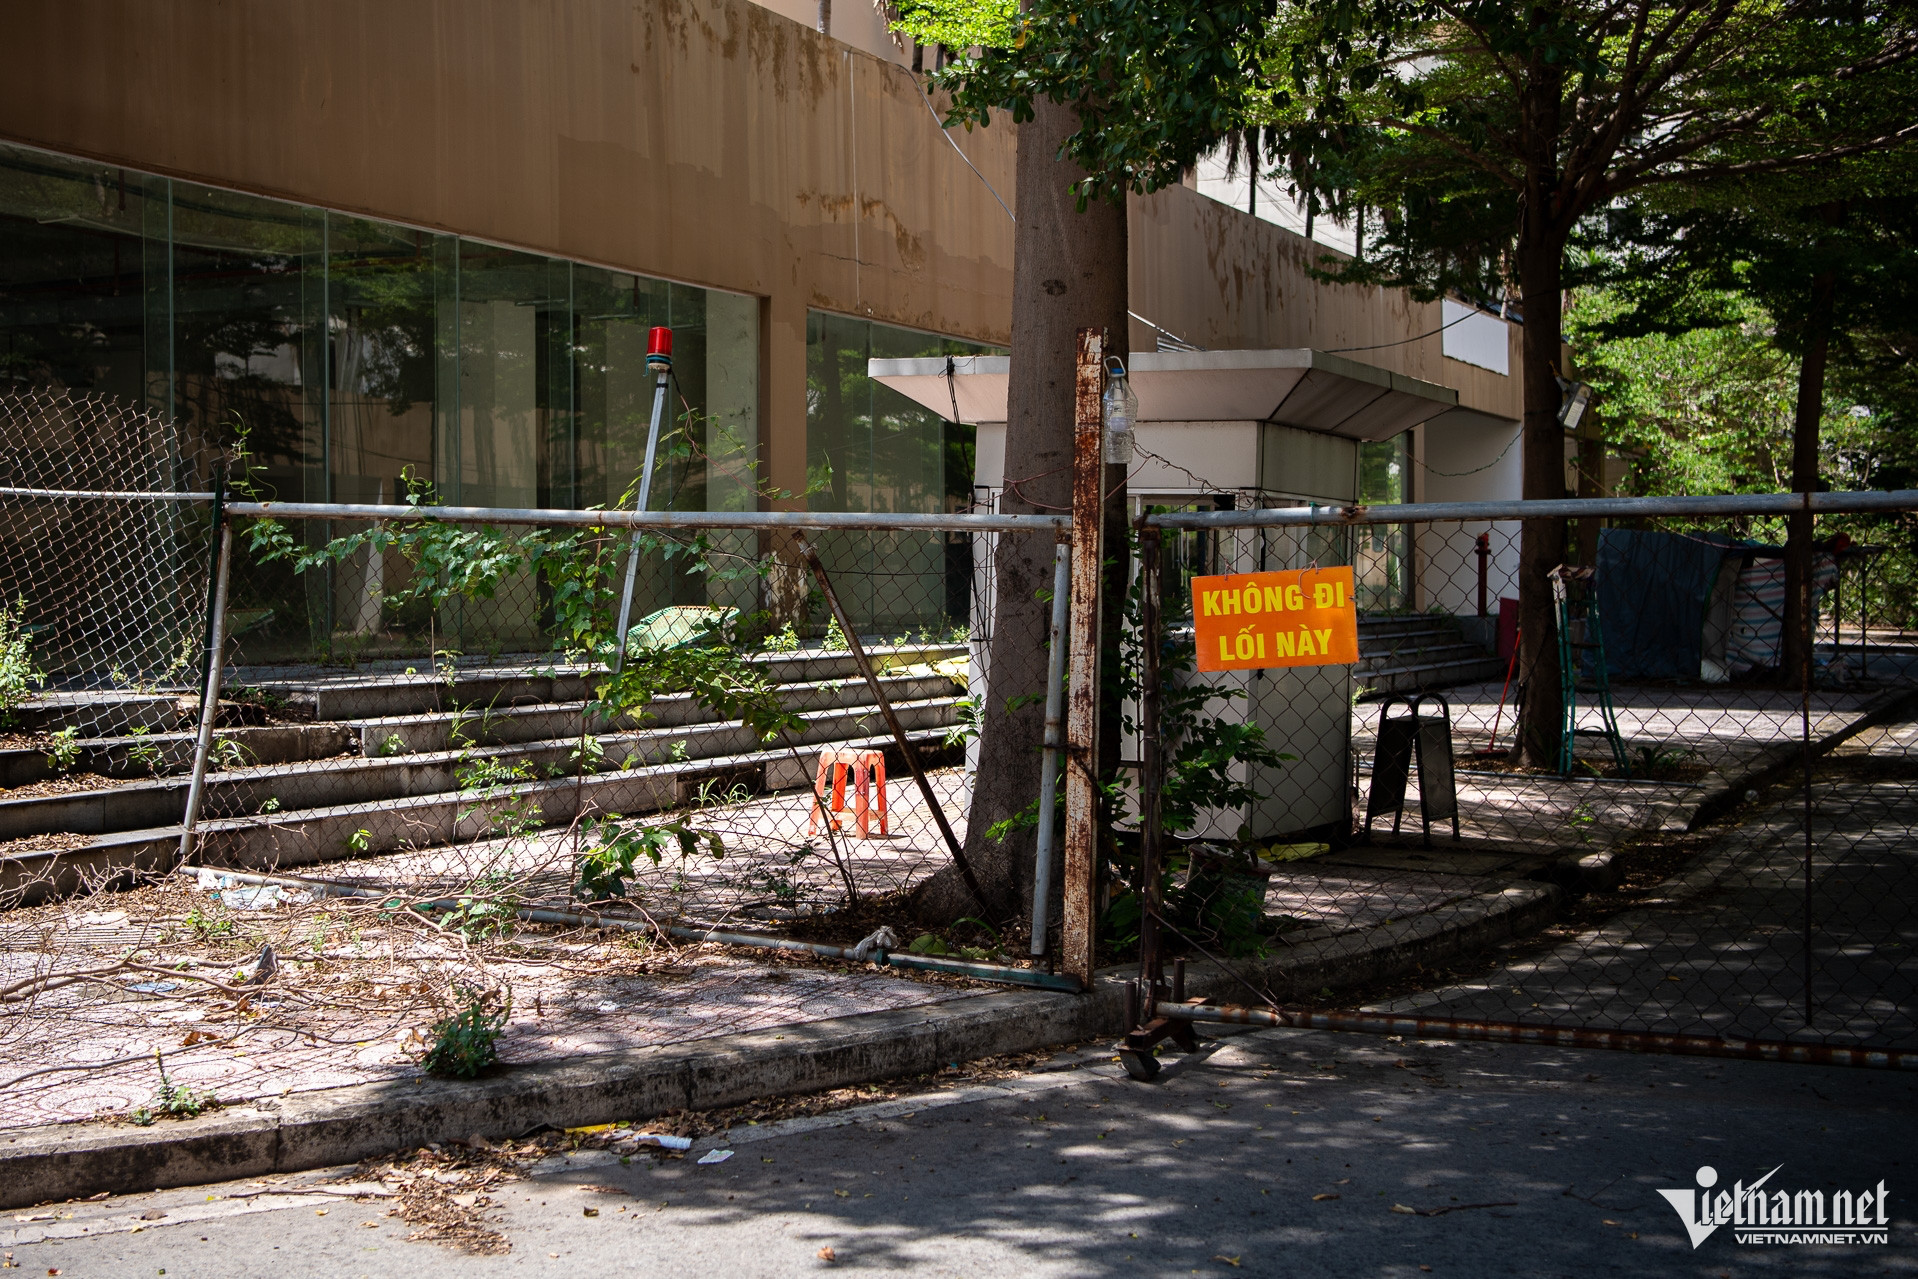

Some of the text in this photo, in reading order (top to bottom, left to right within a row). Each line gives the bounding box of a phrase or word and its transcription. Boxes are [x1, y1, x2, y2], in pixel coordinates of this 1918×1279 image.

[1202, 581, 1345, 617] KHÔNG ĐI
[1219, 624, 1333, 661] LỐI NÀY
